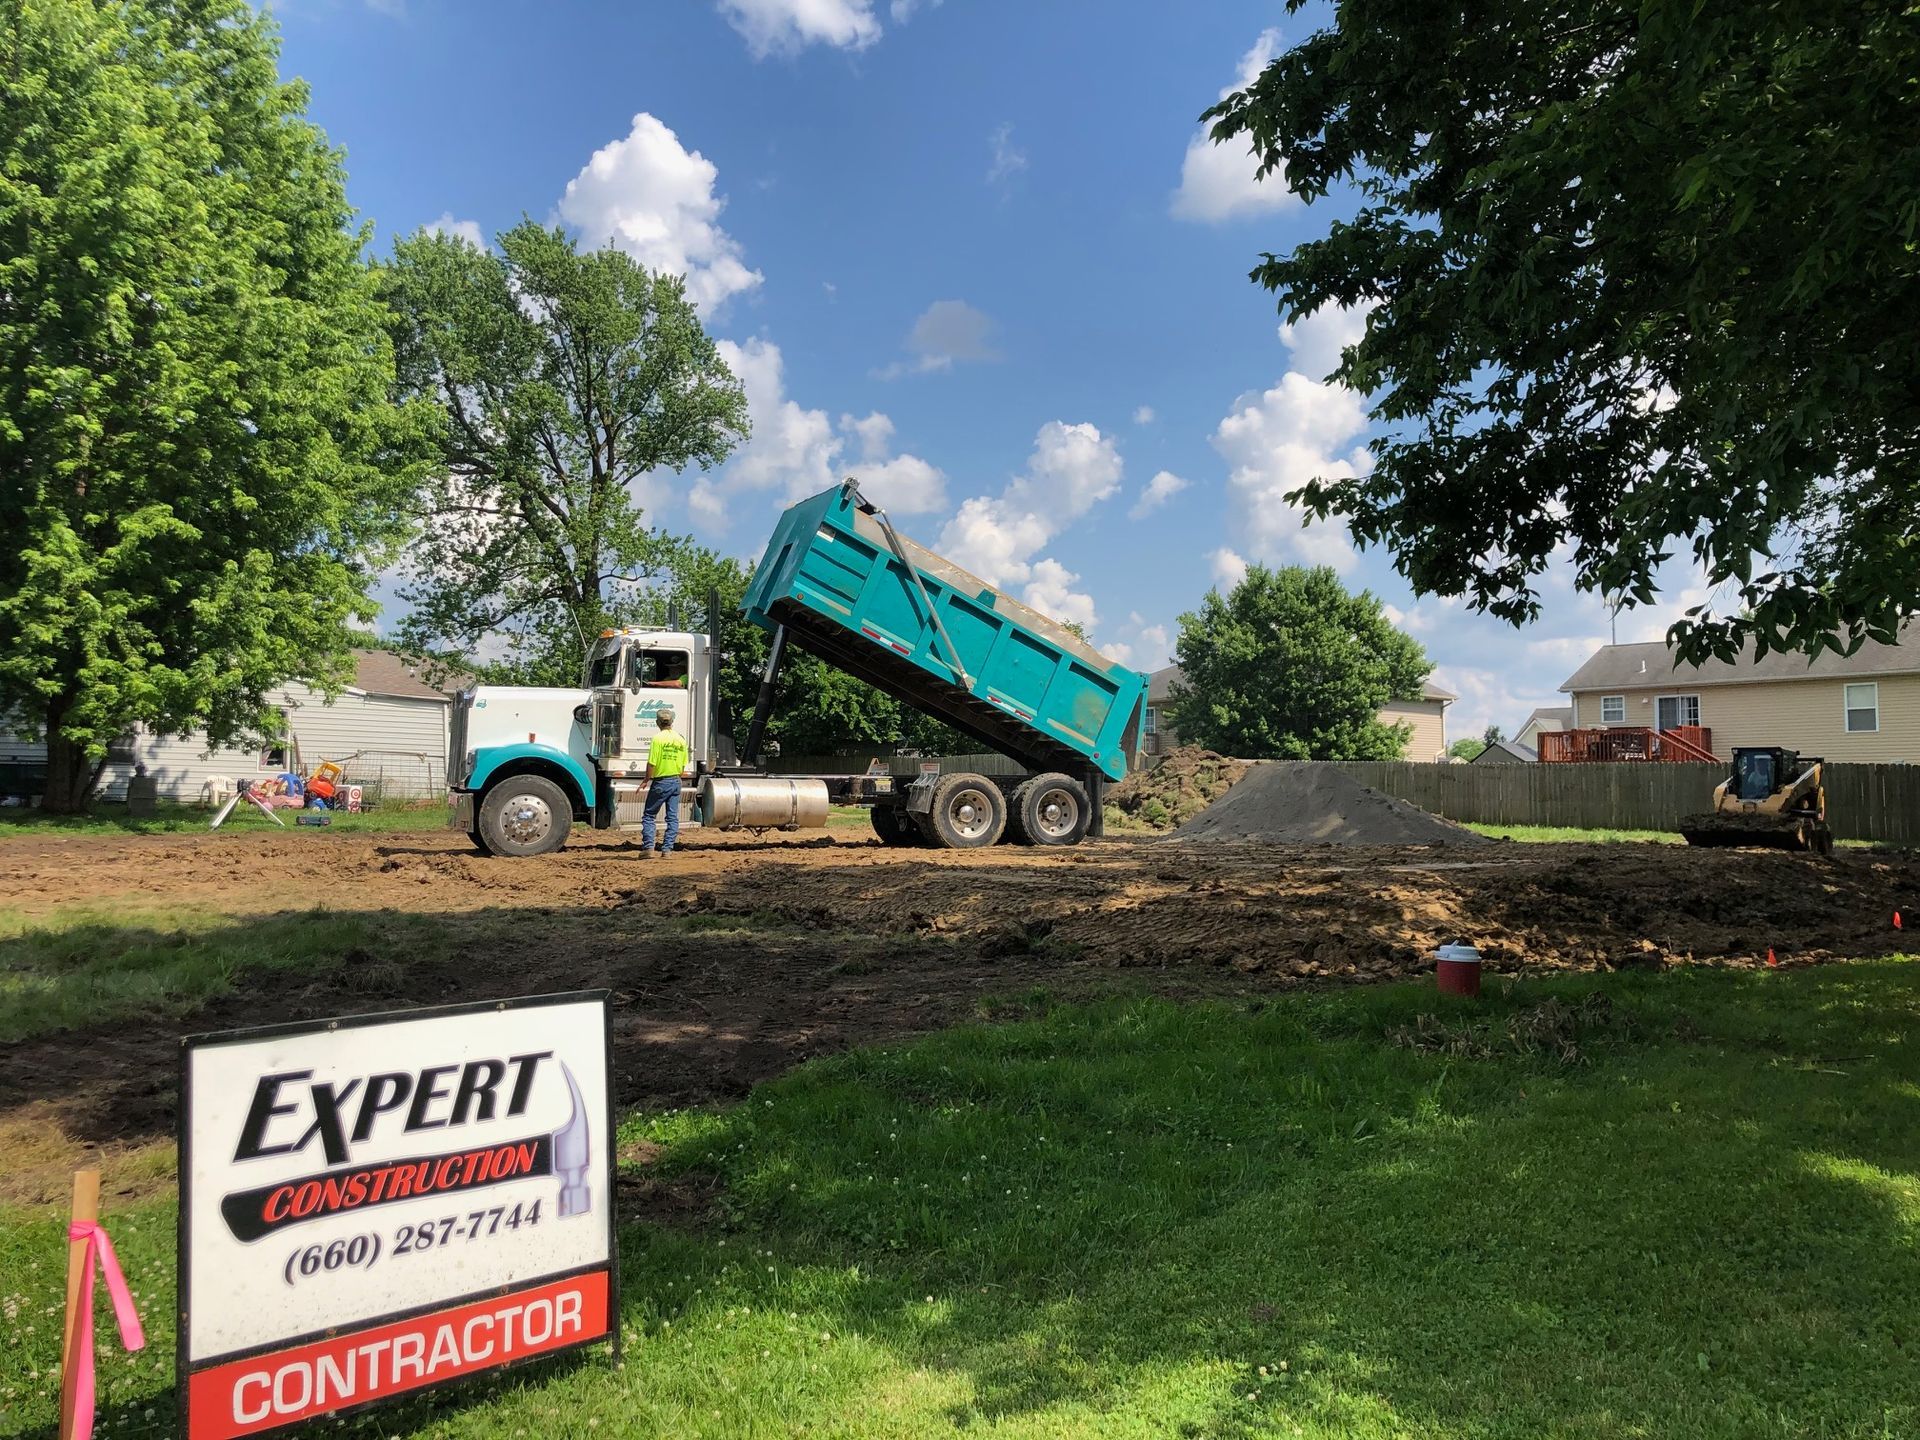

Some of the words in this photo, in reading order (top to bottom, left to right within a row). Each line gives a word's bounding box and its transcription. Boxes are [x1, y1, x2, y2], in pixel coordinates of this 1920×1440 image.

[232, 1050, 554, 1165] EXPERT
[263, 1141, 538, 1223] CONSTRUCTION
[285, 1234, 381, 1286] (660)
[392, 1199, 542, 1257] 287-7744
[233, 1290, 582, 1425] CONTRACTOR
